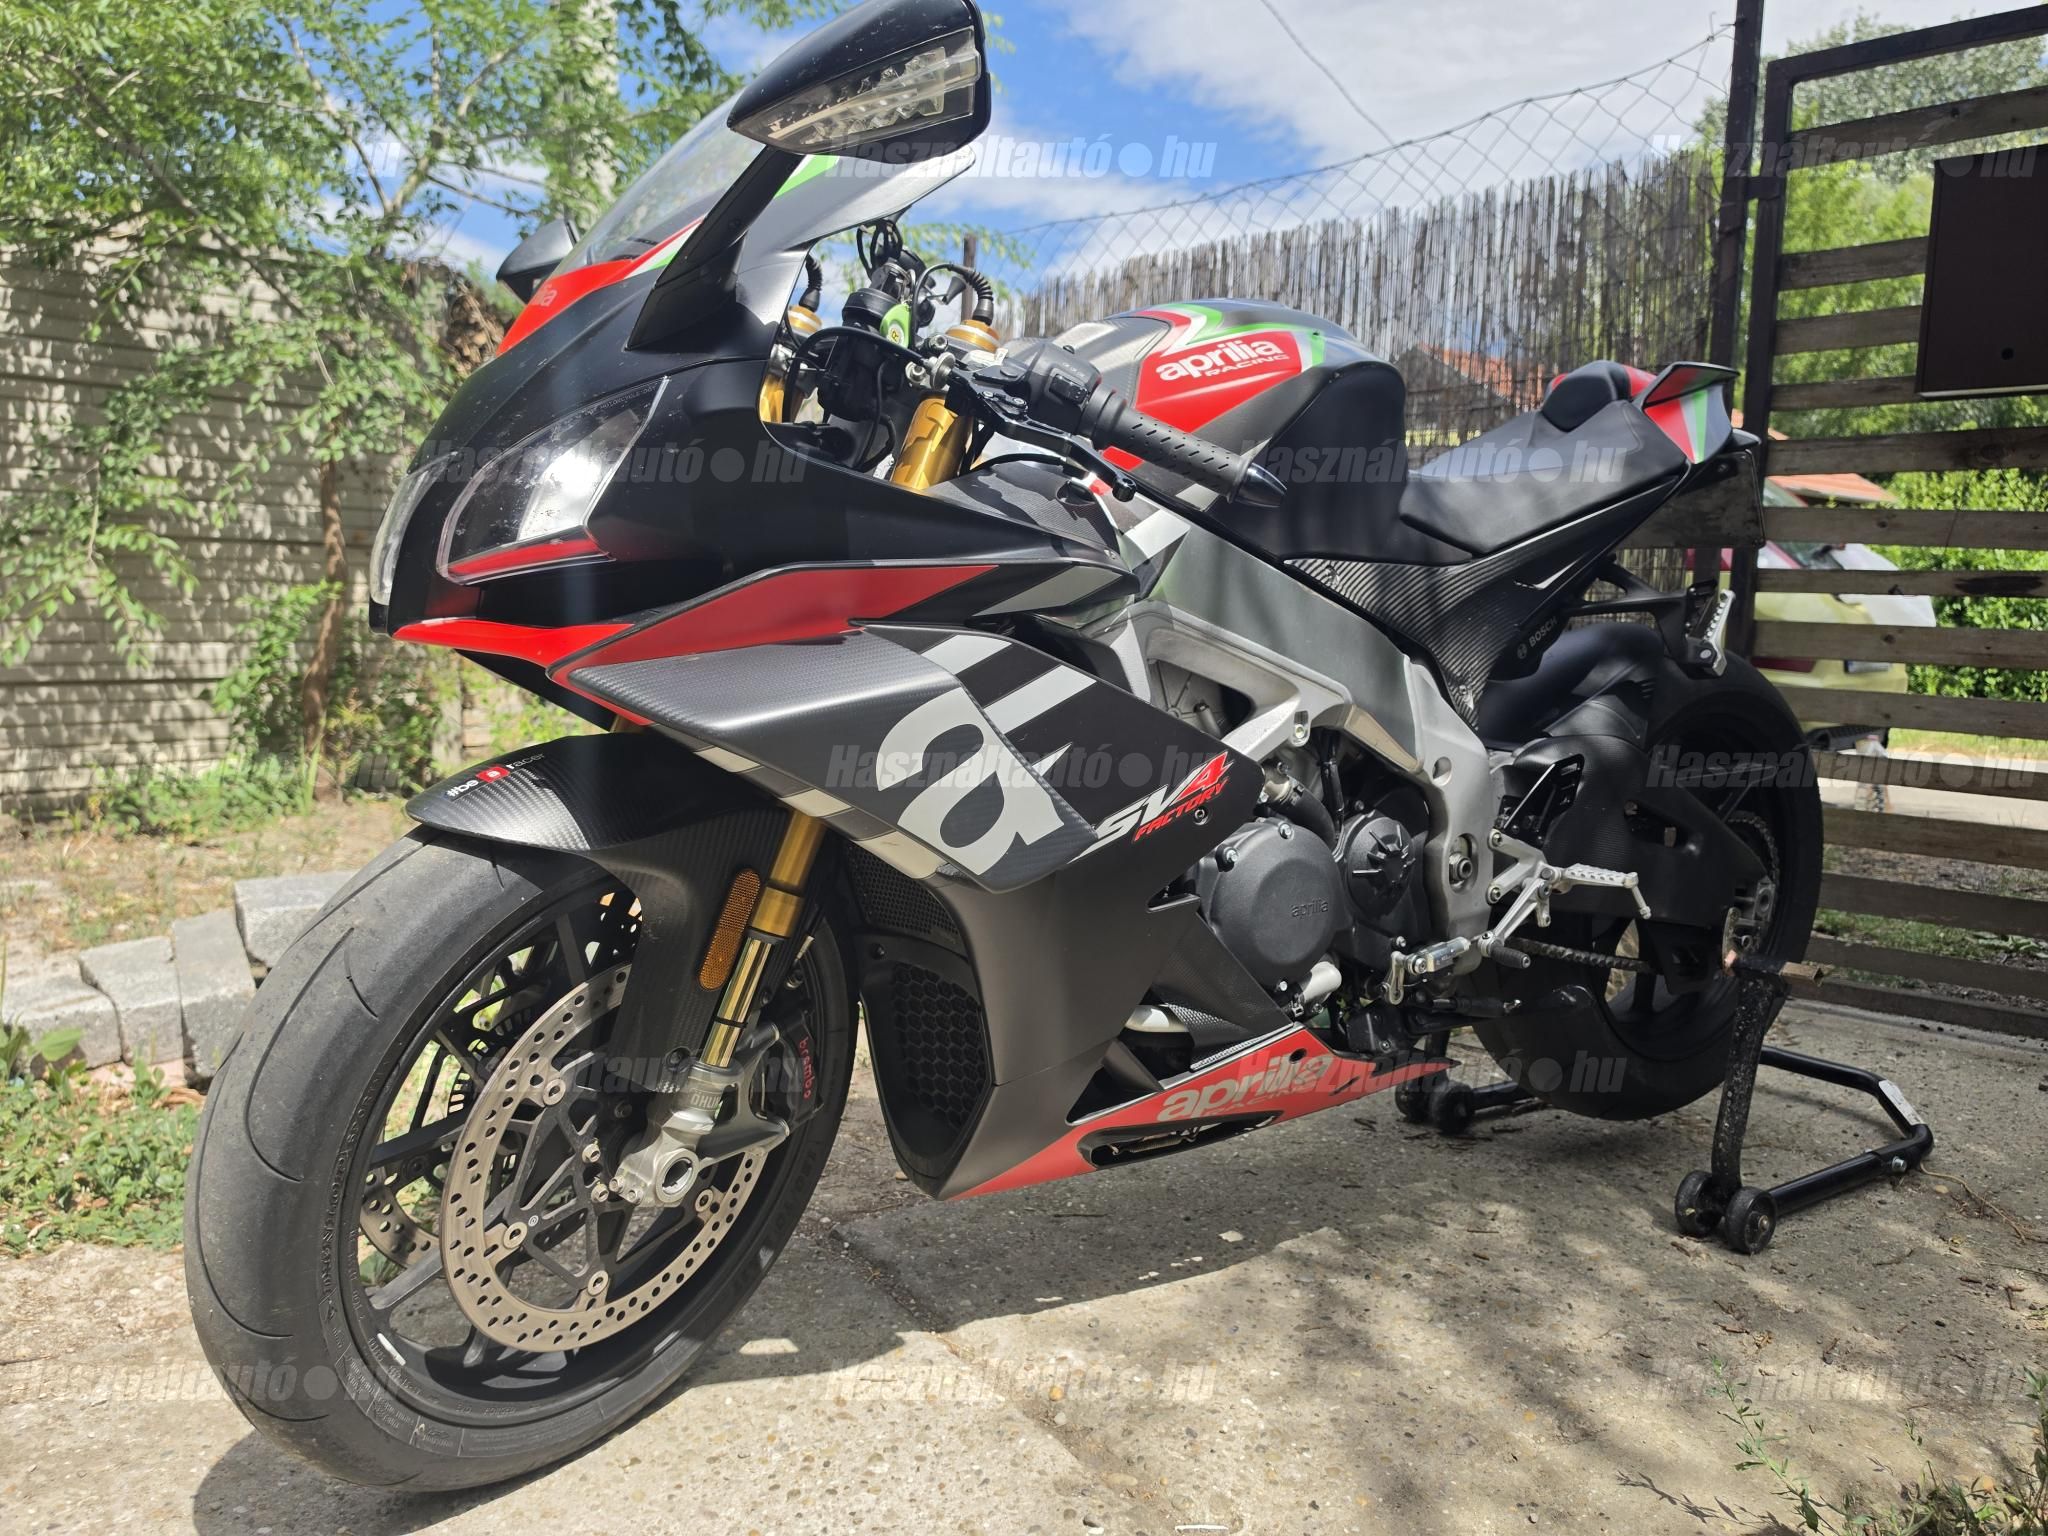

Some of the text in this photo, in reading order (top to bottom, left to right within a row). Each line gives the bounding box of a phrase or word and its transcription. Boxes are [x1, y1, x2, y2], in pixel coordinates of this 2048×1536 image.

[1156, 340, 1284, 380] aprilia
[1204, 354, 1290, 377] RACING
[1529, 616, 1558, 647] BOSCH
[447, 780, 479, 797] #be
[506, 754, 545, 769] racer
[1134, 777, 1230, 842] FACTORY
[1291, 897, 1328, 919] aprilia
[800, 1036, 816, 1099] brembo
[1157, 1053, 1334, 1122] aprilia
